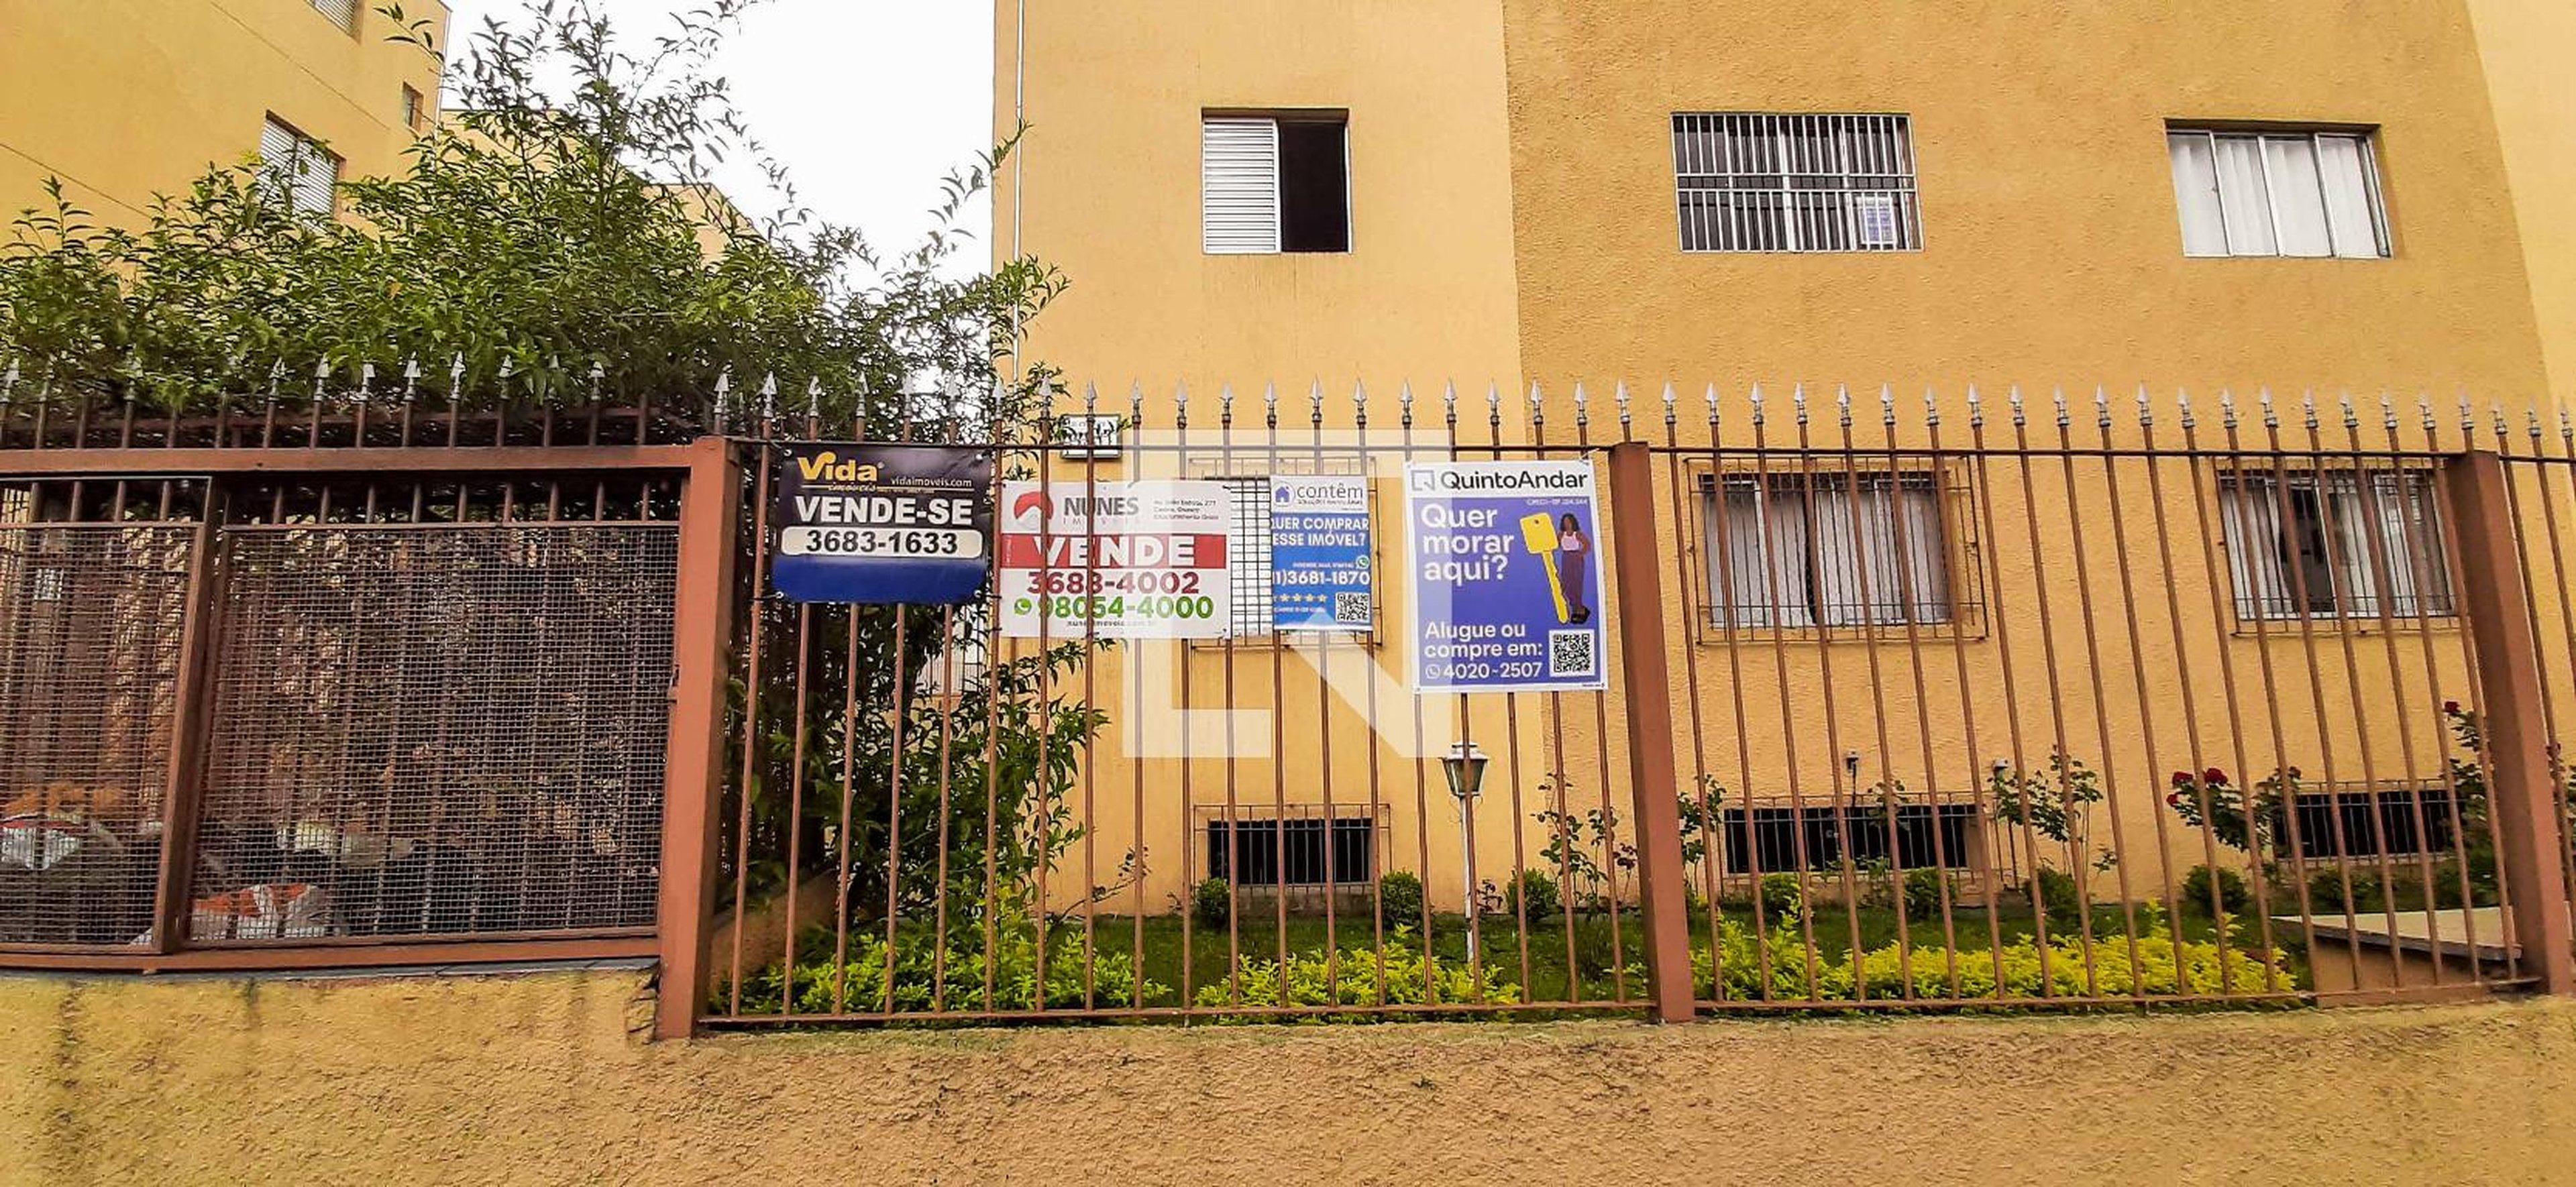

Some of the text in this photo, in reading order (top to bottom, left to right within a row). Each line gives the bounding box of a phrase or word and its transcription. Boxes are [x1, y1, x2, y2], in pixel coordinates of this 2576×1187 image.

[798, 451, 877, 481] Vida
[1441, 470, 1588, 490] QuintoAndar
[1297, 483, 1362, 498] contêm
[795, 496, 973, 524] VENDE-SE
[1064, 497, 1138, 516] NUNES
[1421, 504, 1498, 528] Quer
[1303, 518, 1368, 530] COMPRAR
[806, 530, 958, 554] 3683-1633
[1273, 530, 1366, 547] ESSE IMÓVEL?
[1423, 534, 1514, 555] morar
[1033, 536, 1194, 566] VENDE
[1424, 555, 1508, 587] aqui?
[1426, 622, 1525, 642] Alugue ou
[1424, 642, 1543, 660] compre em:
[1443, 662, 1542, 679] 4020-2507
